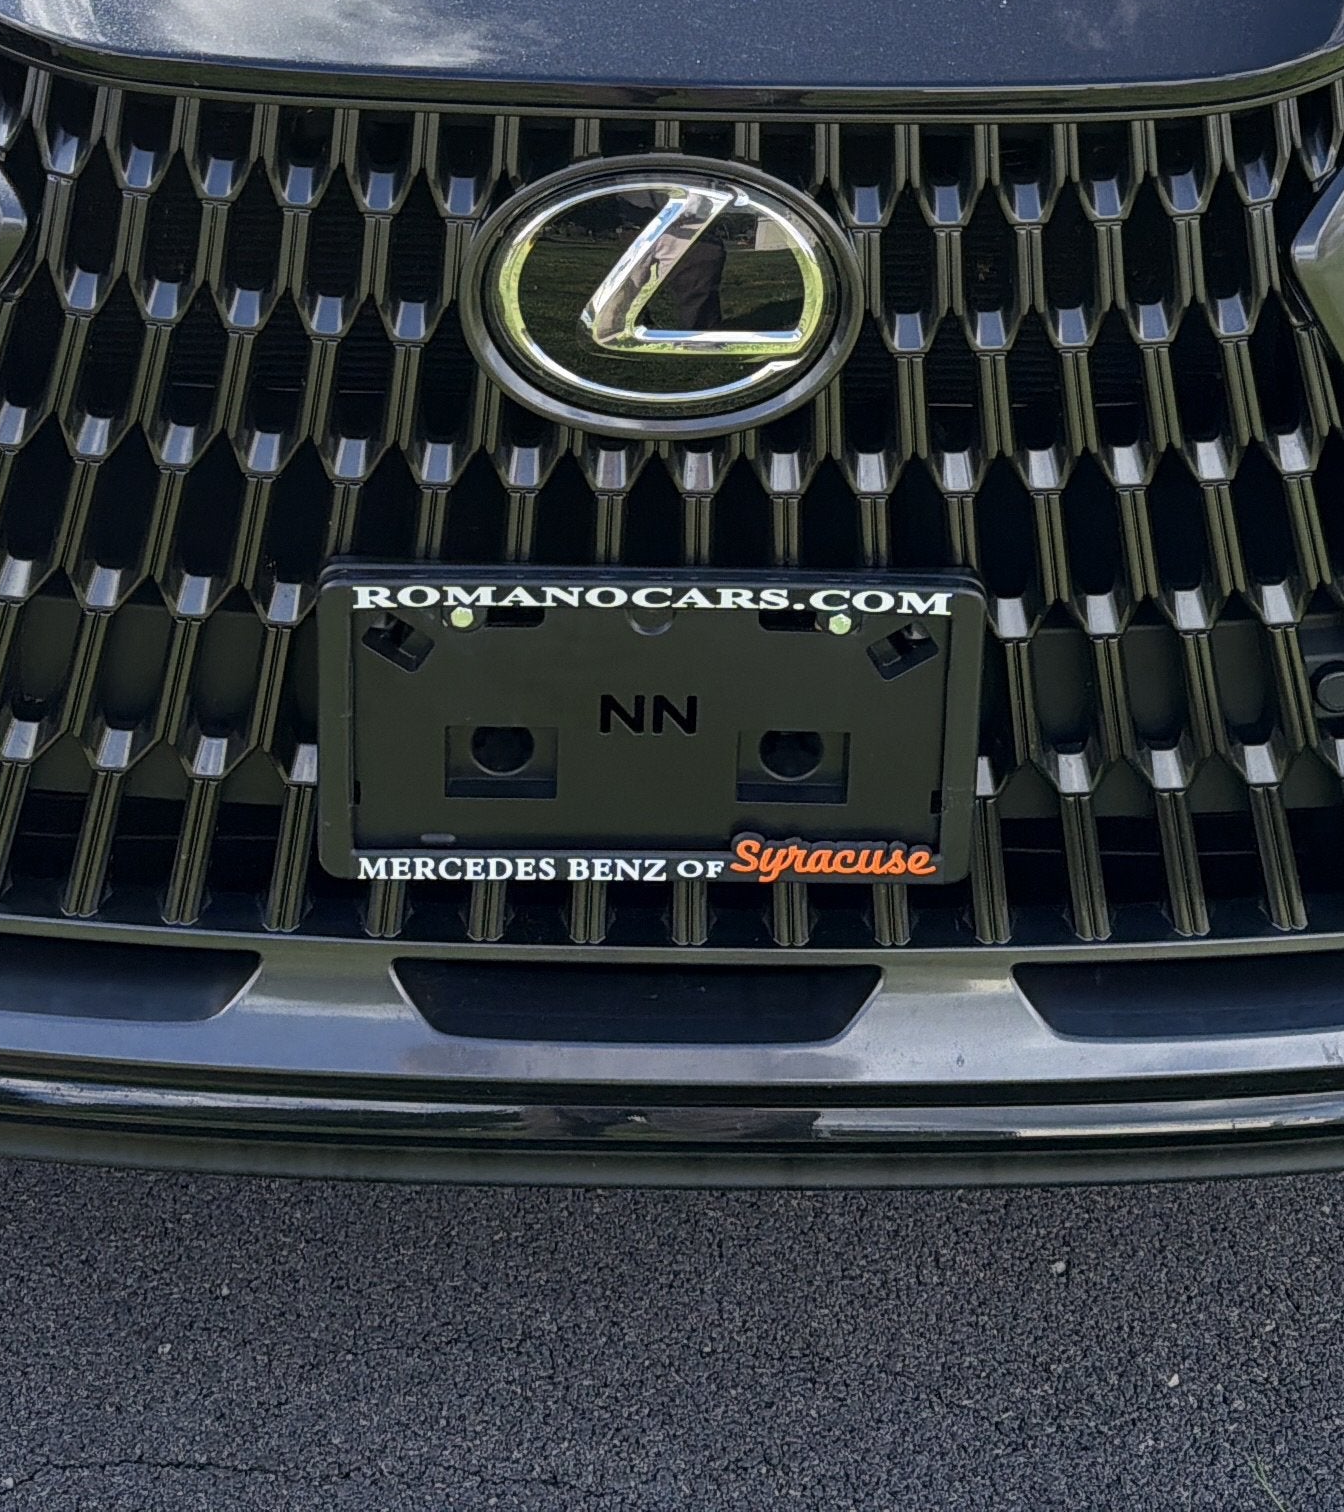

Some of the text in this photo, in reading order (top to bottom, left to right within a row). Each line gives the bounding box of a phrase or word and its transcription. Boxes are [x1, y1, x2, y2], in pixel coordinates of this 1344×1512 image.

[353, 585, 952, 616] ROMANOCARS.COM
[598, 694, 698, 736] NN
[357, 839, 937, 883] MERCEDES BENZ OF Syracuse
